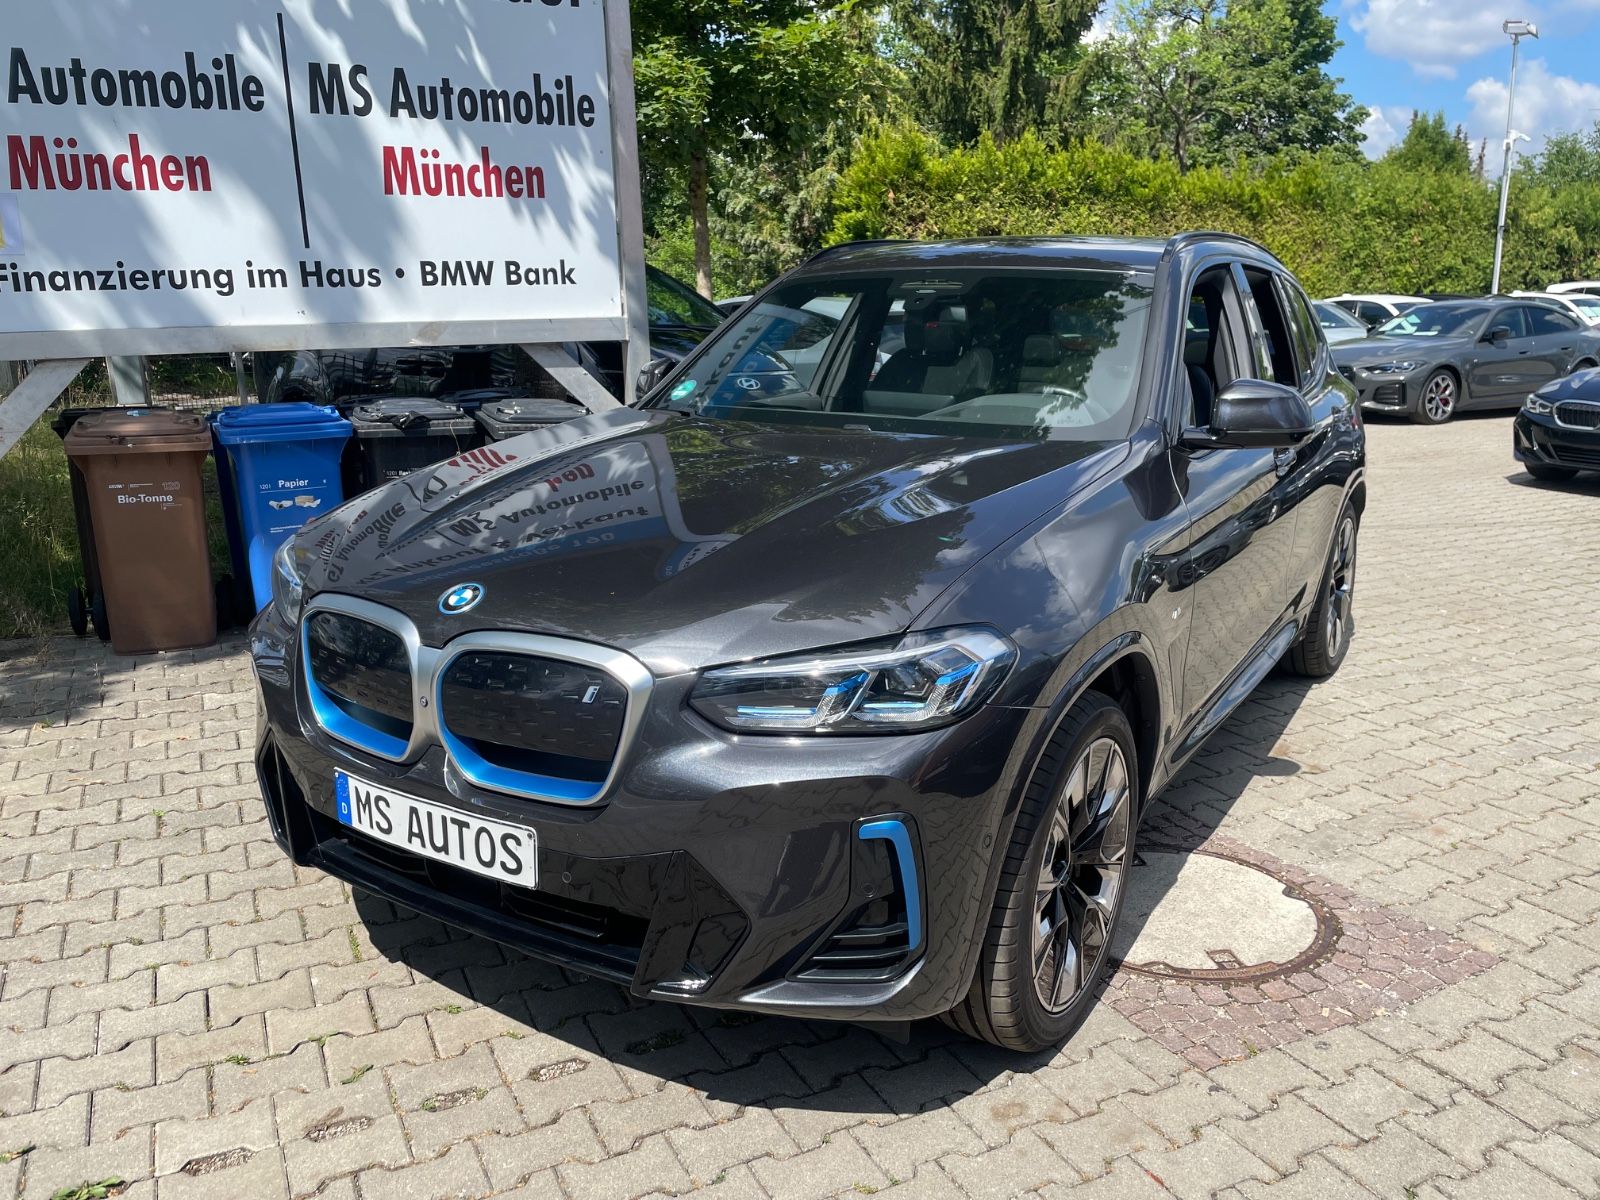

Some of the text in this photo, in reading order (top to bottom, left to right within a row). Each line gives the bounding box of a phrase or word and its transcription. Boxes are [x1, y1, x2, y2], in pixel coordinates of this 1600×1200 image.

[8, 47, 265, 112] Automobile
[308, 62, 596, 127] MS Automobile
[7, 133, 212, 192] München
[383, 146, 545, 198] München
[246, 260, 288, 289] im
[300, 260, 382, 288] Haus
[420, 260, 494, 286] BMW
[505, 260, 577, 286] Bank
[117, 494, 173, 504] Bio-Tonne
[278, 479, 309, 489] Papier
[341, 801, 348, 815] D
[354, 785, 523, 876] MS AUTOS
